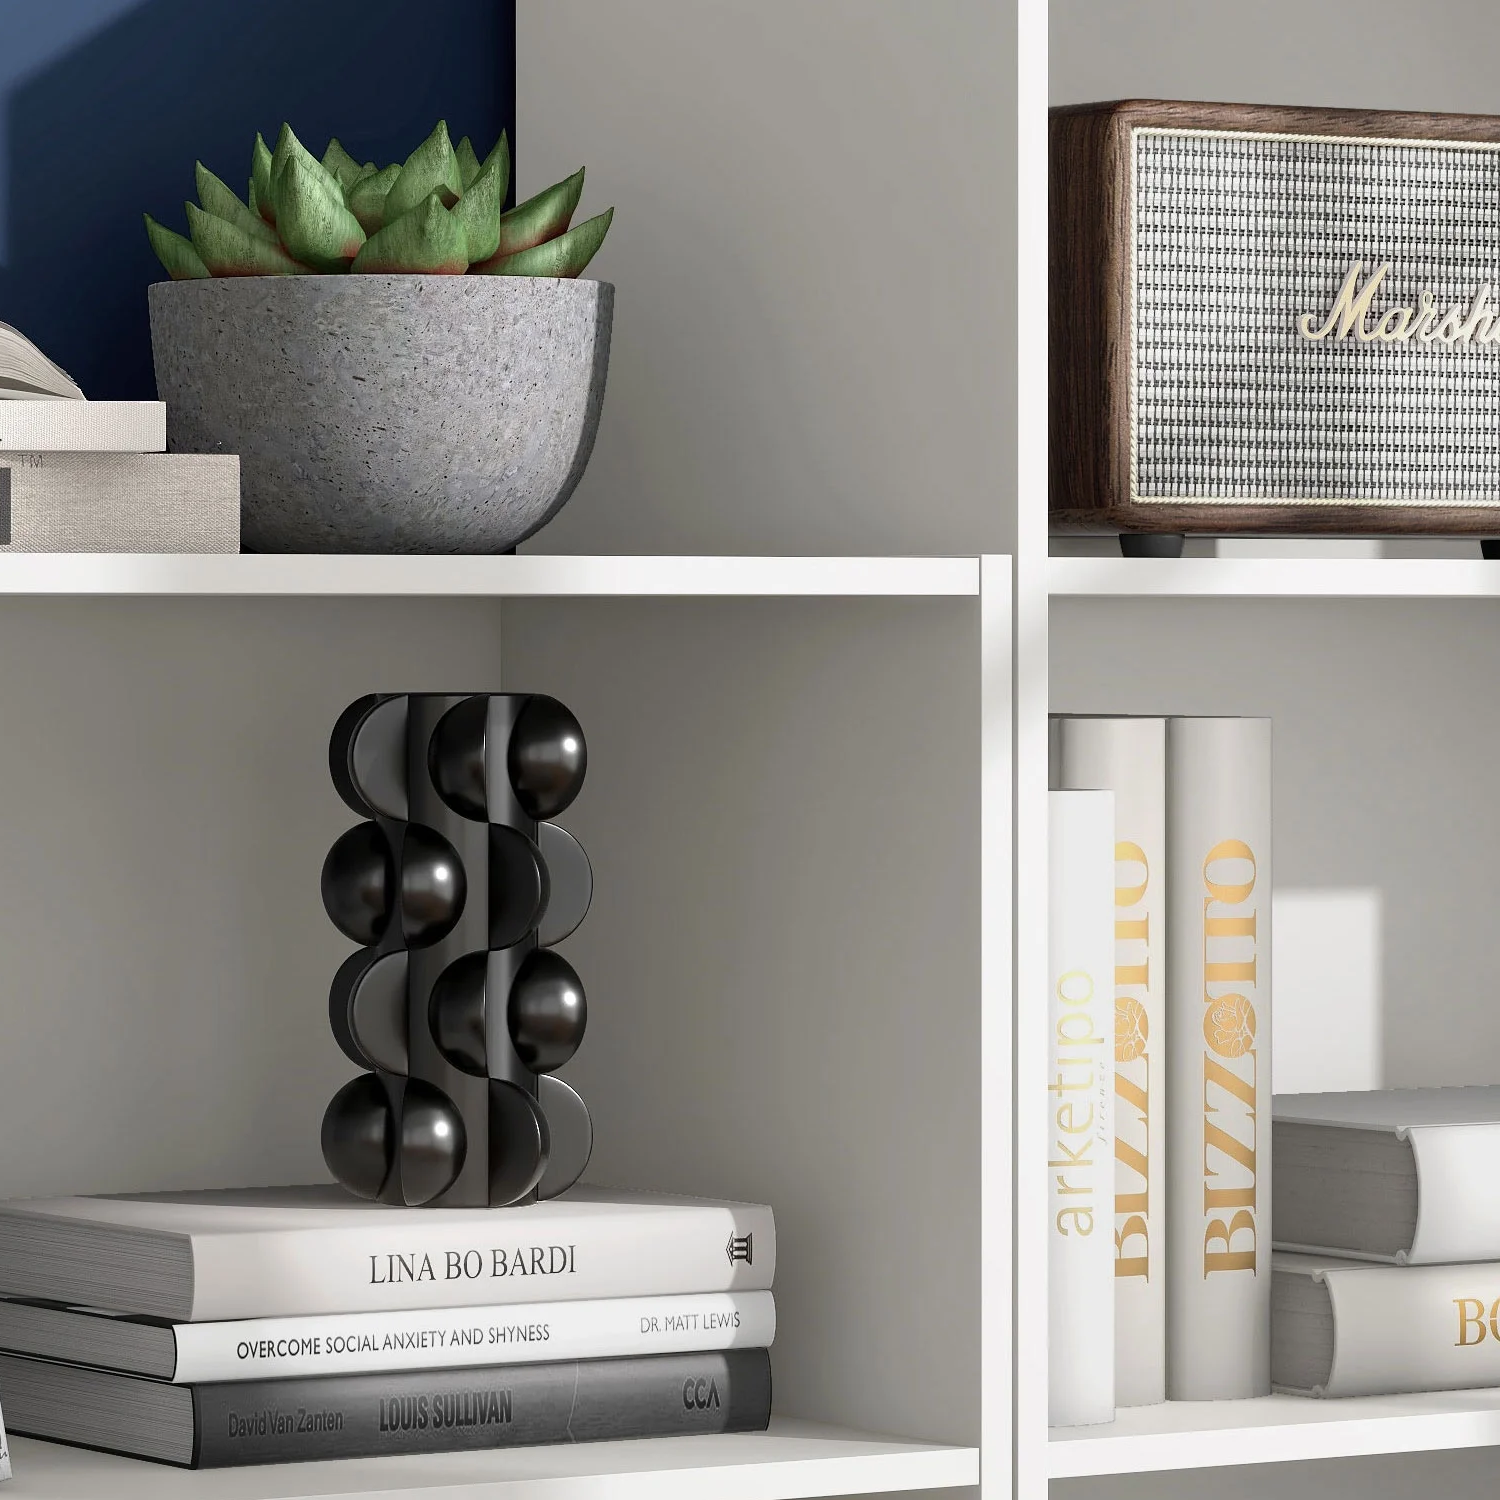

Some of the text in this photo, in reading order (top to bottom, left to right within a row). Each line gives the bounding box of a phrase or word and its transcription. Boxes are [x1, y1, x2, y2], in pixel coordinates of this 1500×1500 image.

[369, 1245, 577, 1284] LINA BO BARDI
[640, 1311, 741, 1333] DR. MATT LEWIS
[237, 1324, 550, 1360] OVERCOME SOCIAL ANXIETY AND SHYNESS
[378, 1389, 513, 1431] LOUIS SULLIVAN
[682, 1377, 721, 1411] CCA
[228, 1408, 343, 1438] David Van Zanten
